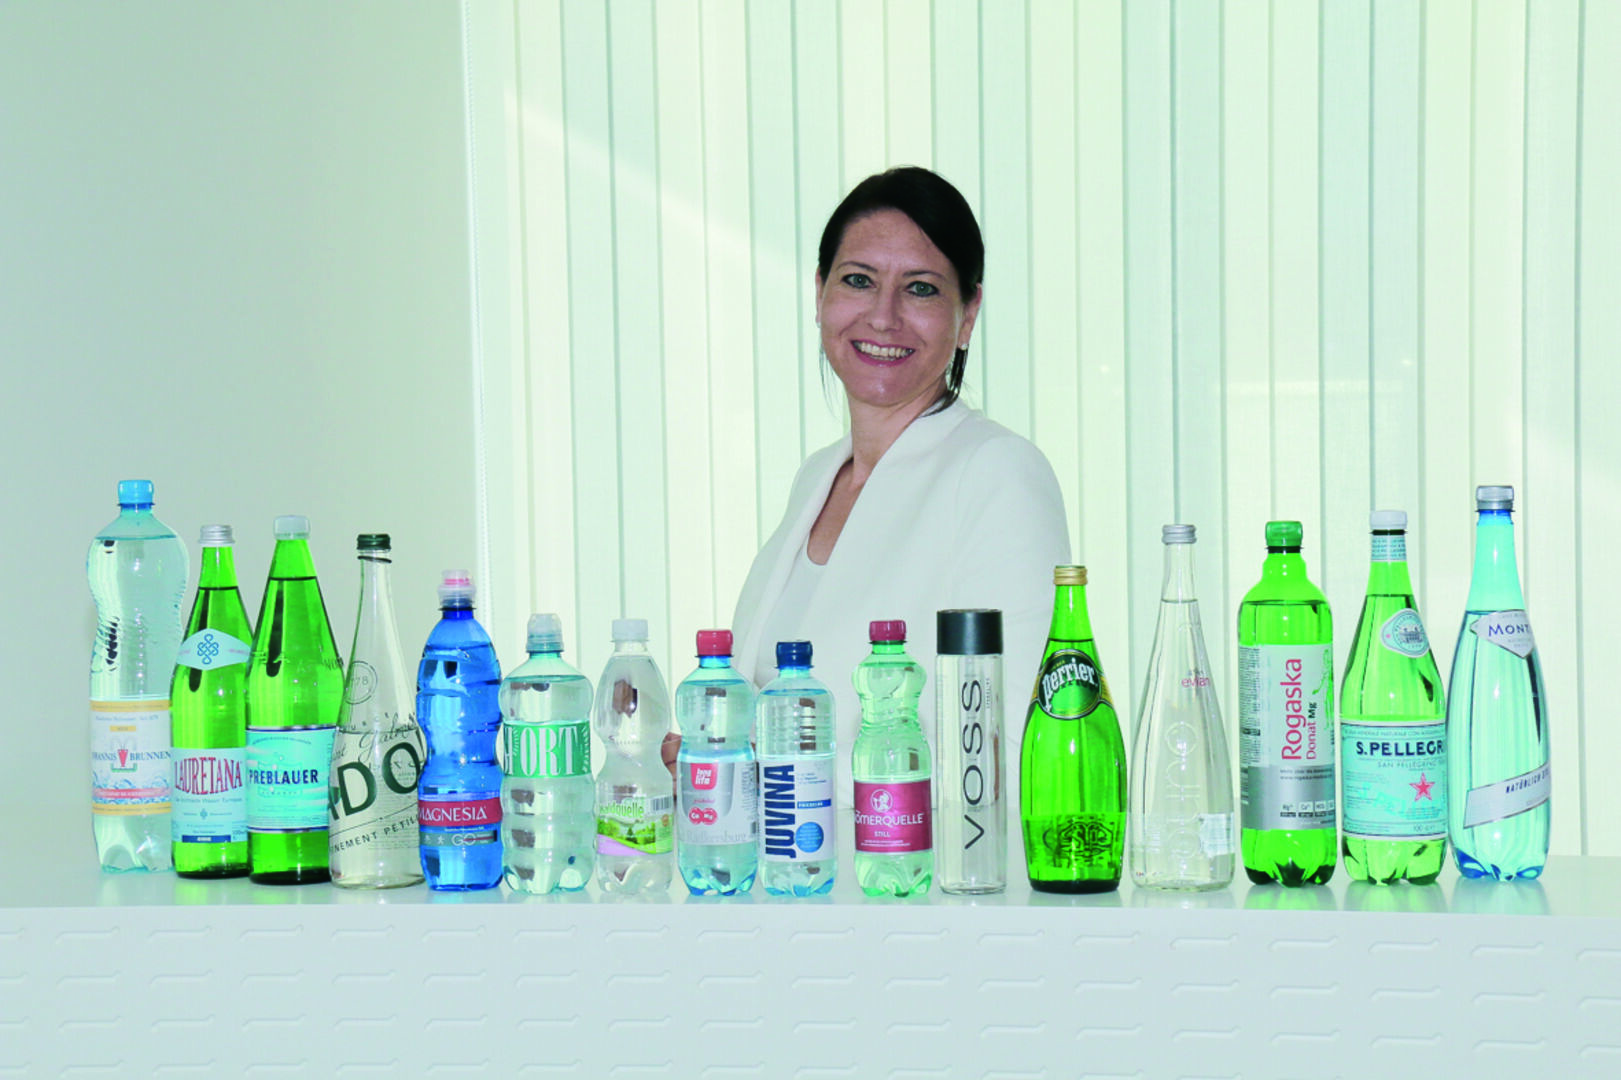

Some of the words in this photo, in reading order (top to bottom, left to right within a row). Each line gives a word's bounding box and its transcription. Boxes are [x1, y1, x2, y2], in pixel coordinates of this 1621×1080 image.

[1042, 657, 1095, 712] perrier
[130, 751, 171, 761] BRUNNEN
[1306, 722, 1317, 760] Donat
[174, 757, 243, 796] LAURETANA
[249, 769, 320, 785] PREBLAUER
[962, 680, 985, 849] VOSS
[763, 764, 797, 859] JUVINA
[855, 810, 925, 828] ÖMERQUELLE
